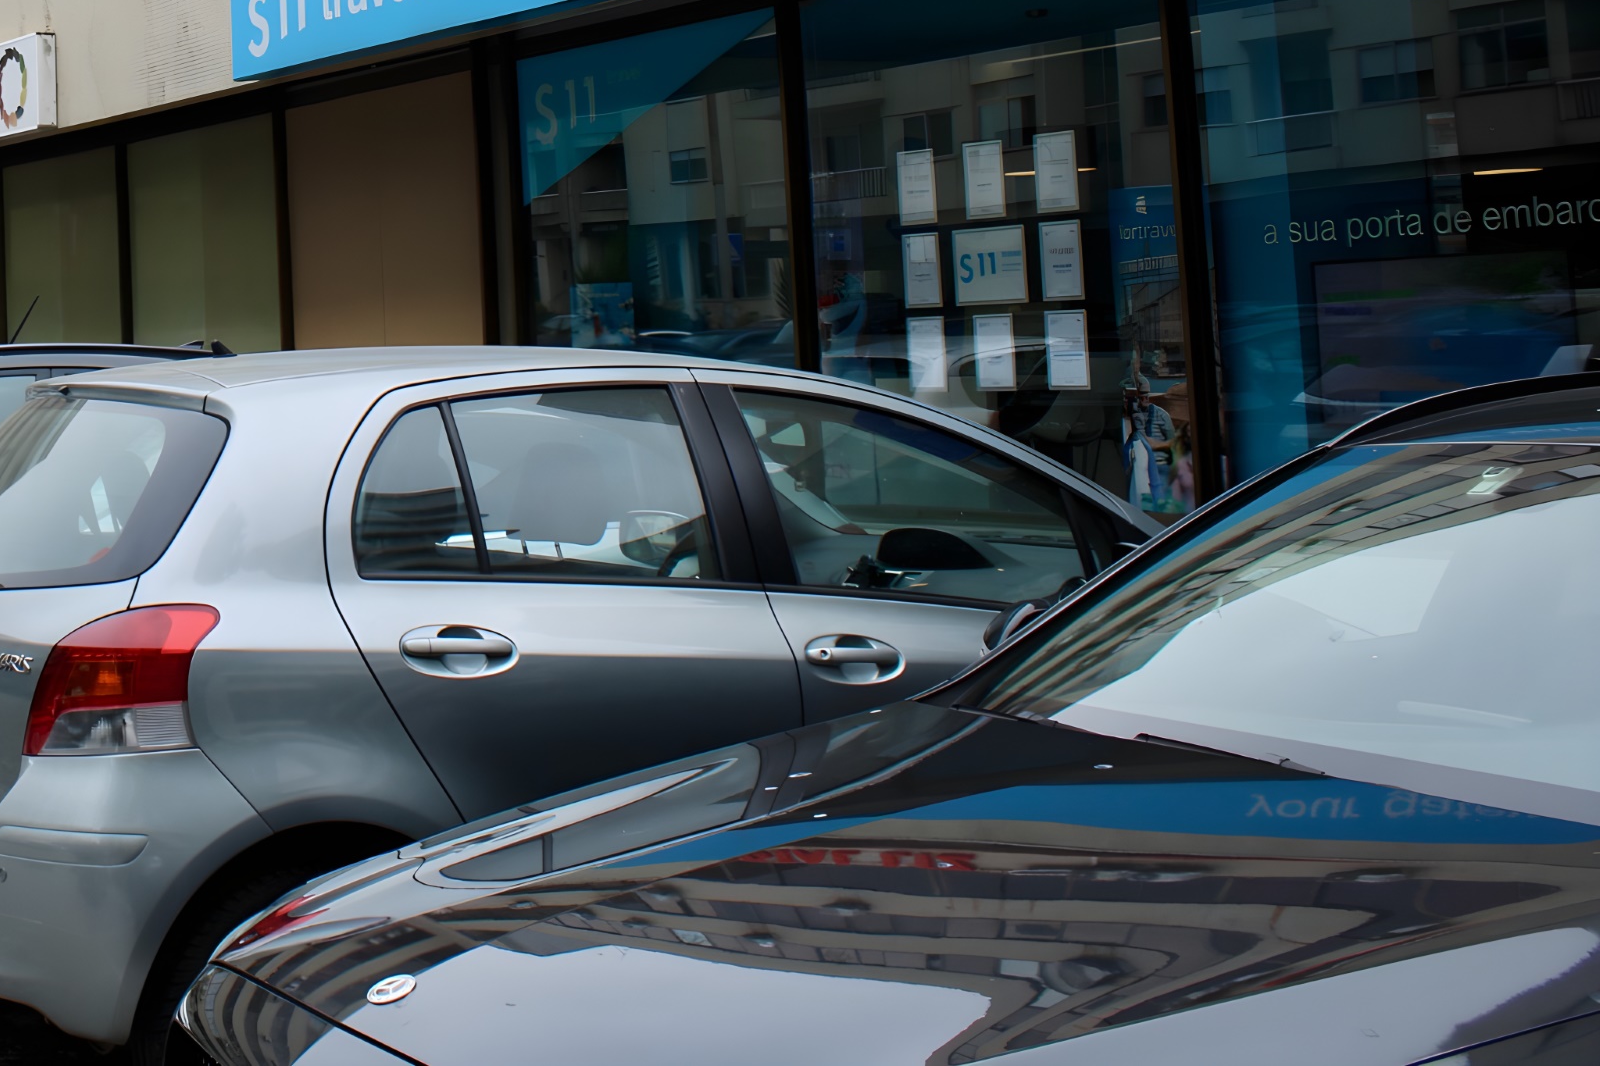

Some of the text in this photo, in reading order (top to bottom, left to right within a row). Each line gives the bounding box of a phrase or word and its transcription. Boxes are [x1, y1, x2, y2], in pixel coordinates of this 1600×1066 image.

[1263, 221, 1279, 246] a
[1288, 217, 1338, 243] sua
[1346, 208, 1424, 248] porta
[1434, 204, 1473, 235] de
